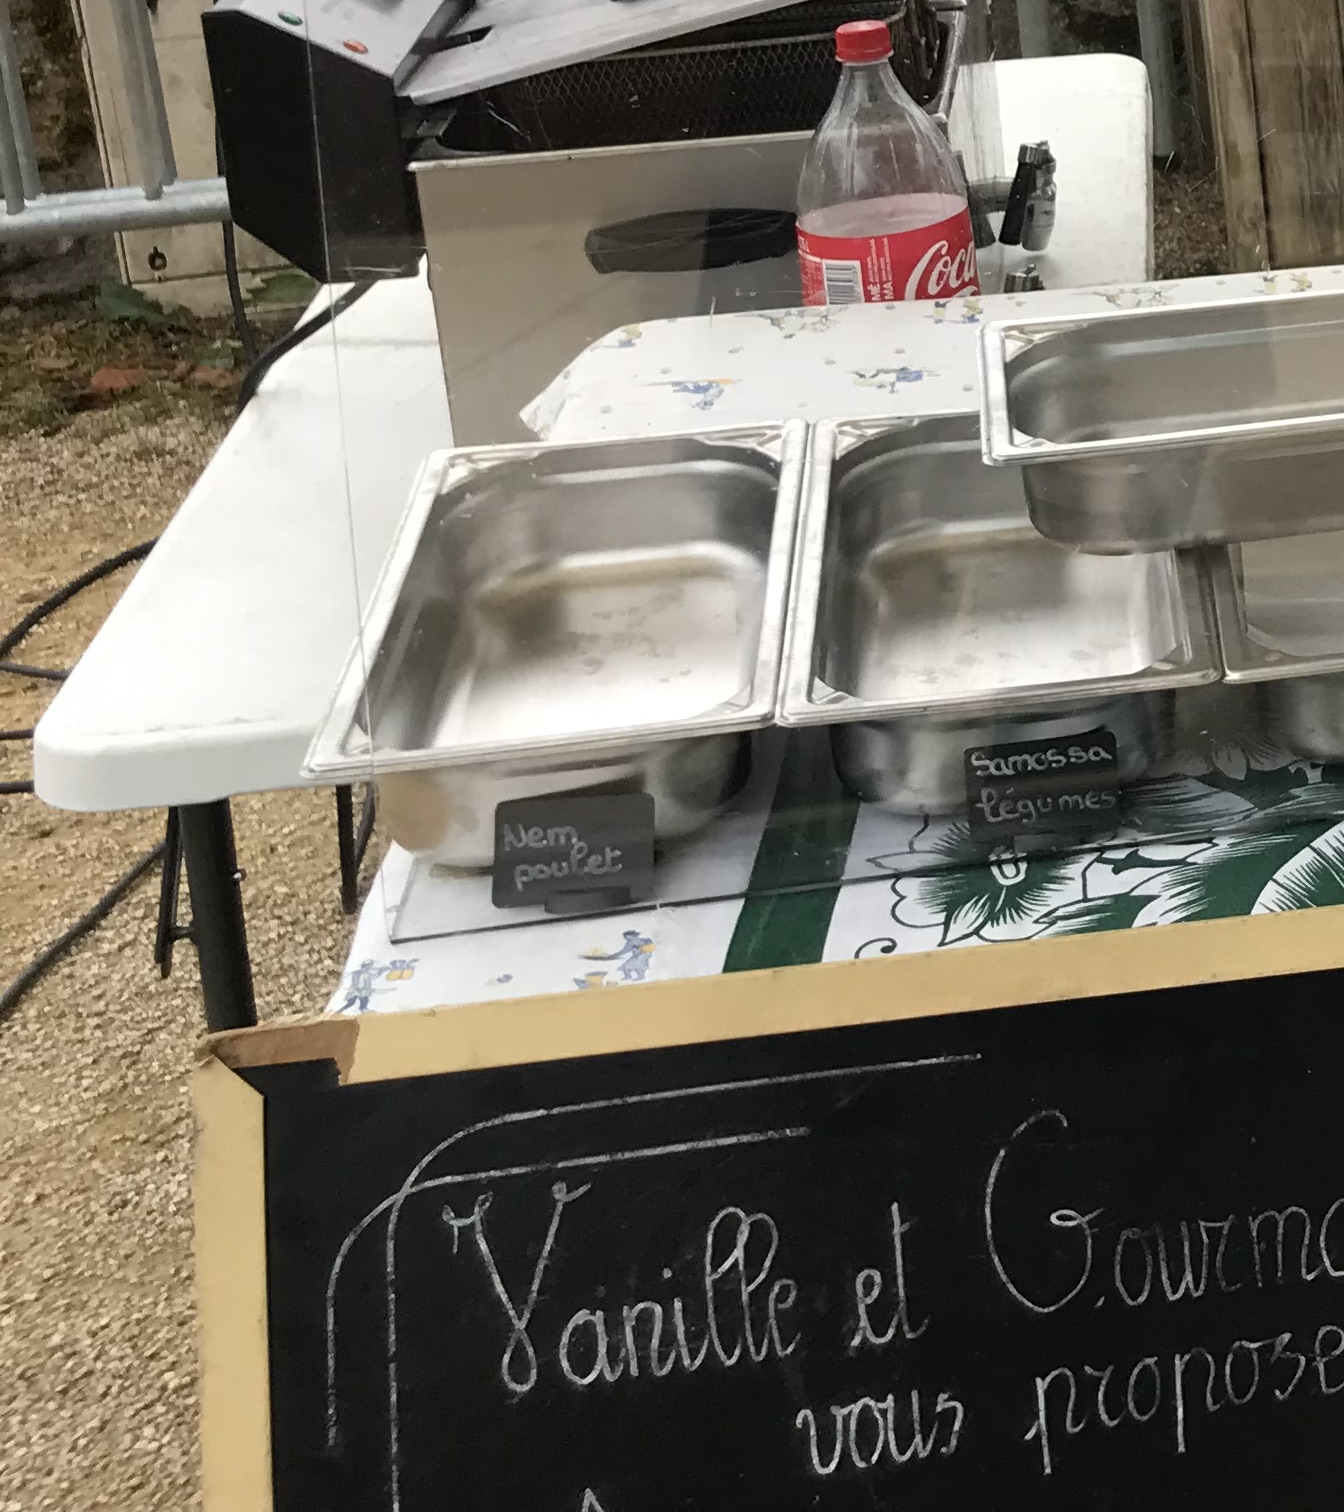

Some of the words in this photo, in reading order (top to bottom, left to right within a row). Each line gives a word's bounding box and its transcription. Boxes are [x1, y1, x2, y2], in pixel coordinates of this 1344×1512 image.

[971, 745, 1113, 777] Samossa
[975, 787, 1117, 823] légumes
[503, 824, 578, 851] Nem
[514, 841, 623, 892] poulet
[442, 1182, 801, 1396] Vanille
[848, 1202, 929, 1354] et
[796, 1389, 965, 1475] vous
